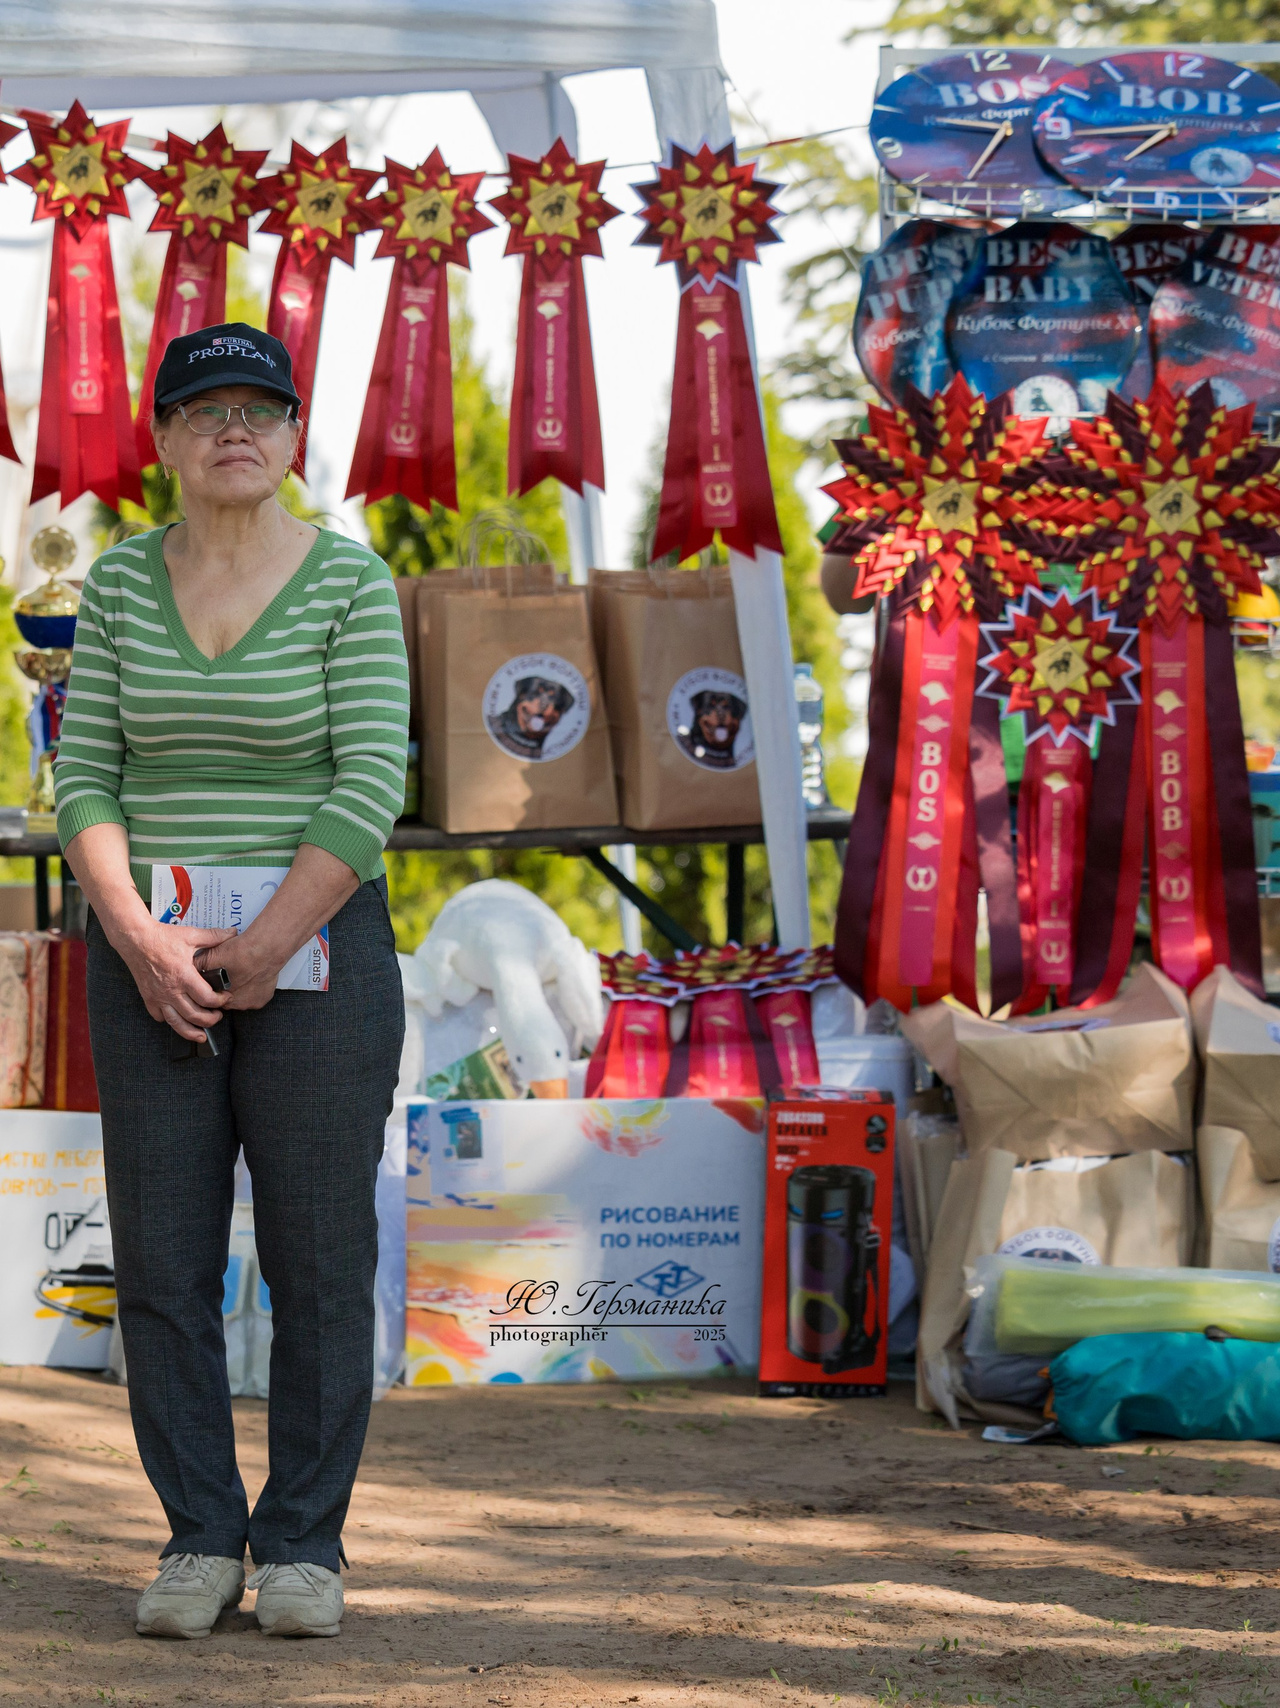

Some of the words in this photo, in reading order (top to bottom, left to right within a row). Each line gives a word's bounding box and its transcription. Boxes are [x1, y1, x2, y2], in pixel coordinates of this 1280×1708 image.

[1164, 53, 1204, 78] 12
[1120, 84, 1243, 116] BOB
[1044, 116, 1069, 140] 9
[986, 237, 1099, 267] BEST
[984, 274, 1093, 303] BABY
[956, 315, 1016, 334] Кубок
[222, 338, 251, 347] PURINA
[915, 741, 942, 822] BOS
[1160, 750, 1183, 831] BOB
[312, 949, 321, 983] SIRIUS
[600, 1205, 740, 1224] РИСОВАНИЕ
[600, 1233, 632, 1249] ПО
[637, 1231, 741, 1249] НОМЕРАМ
